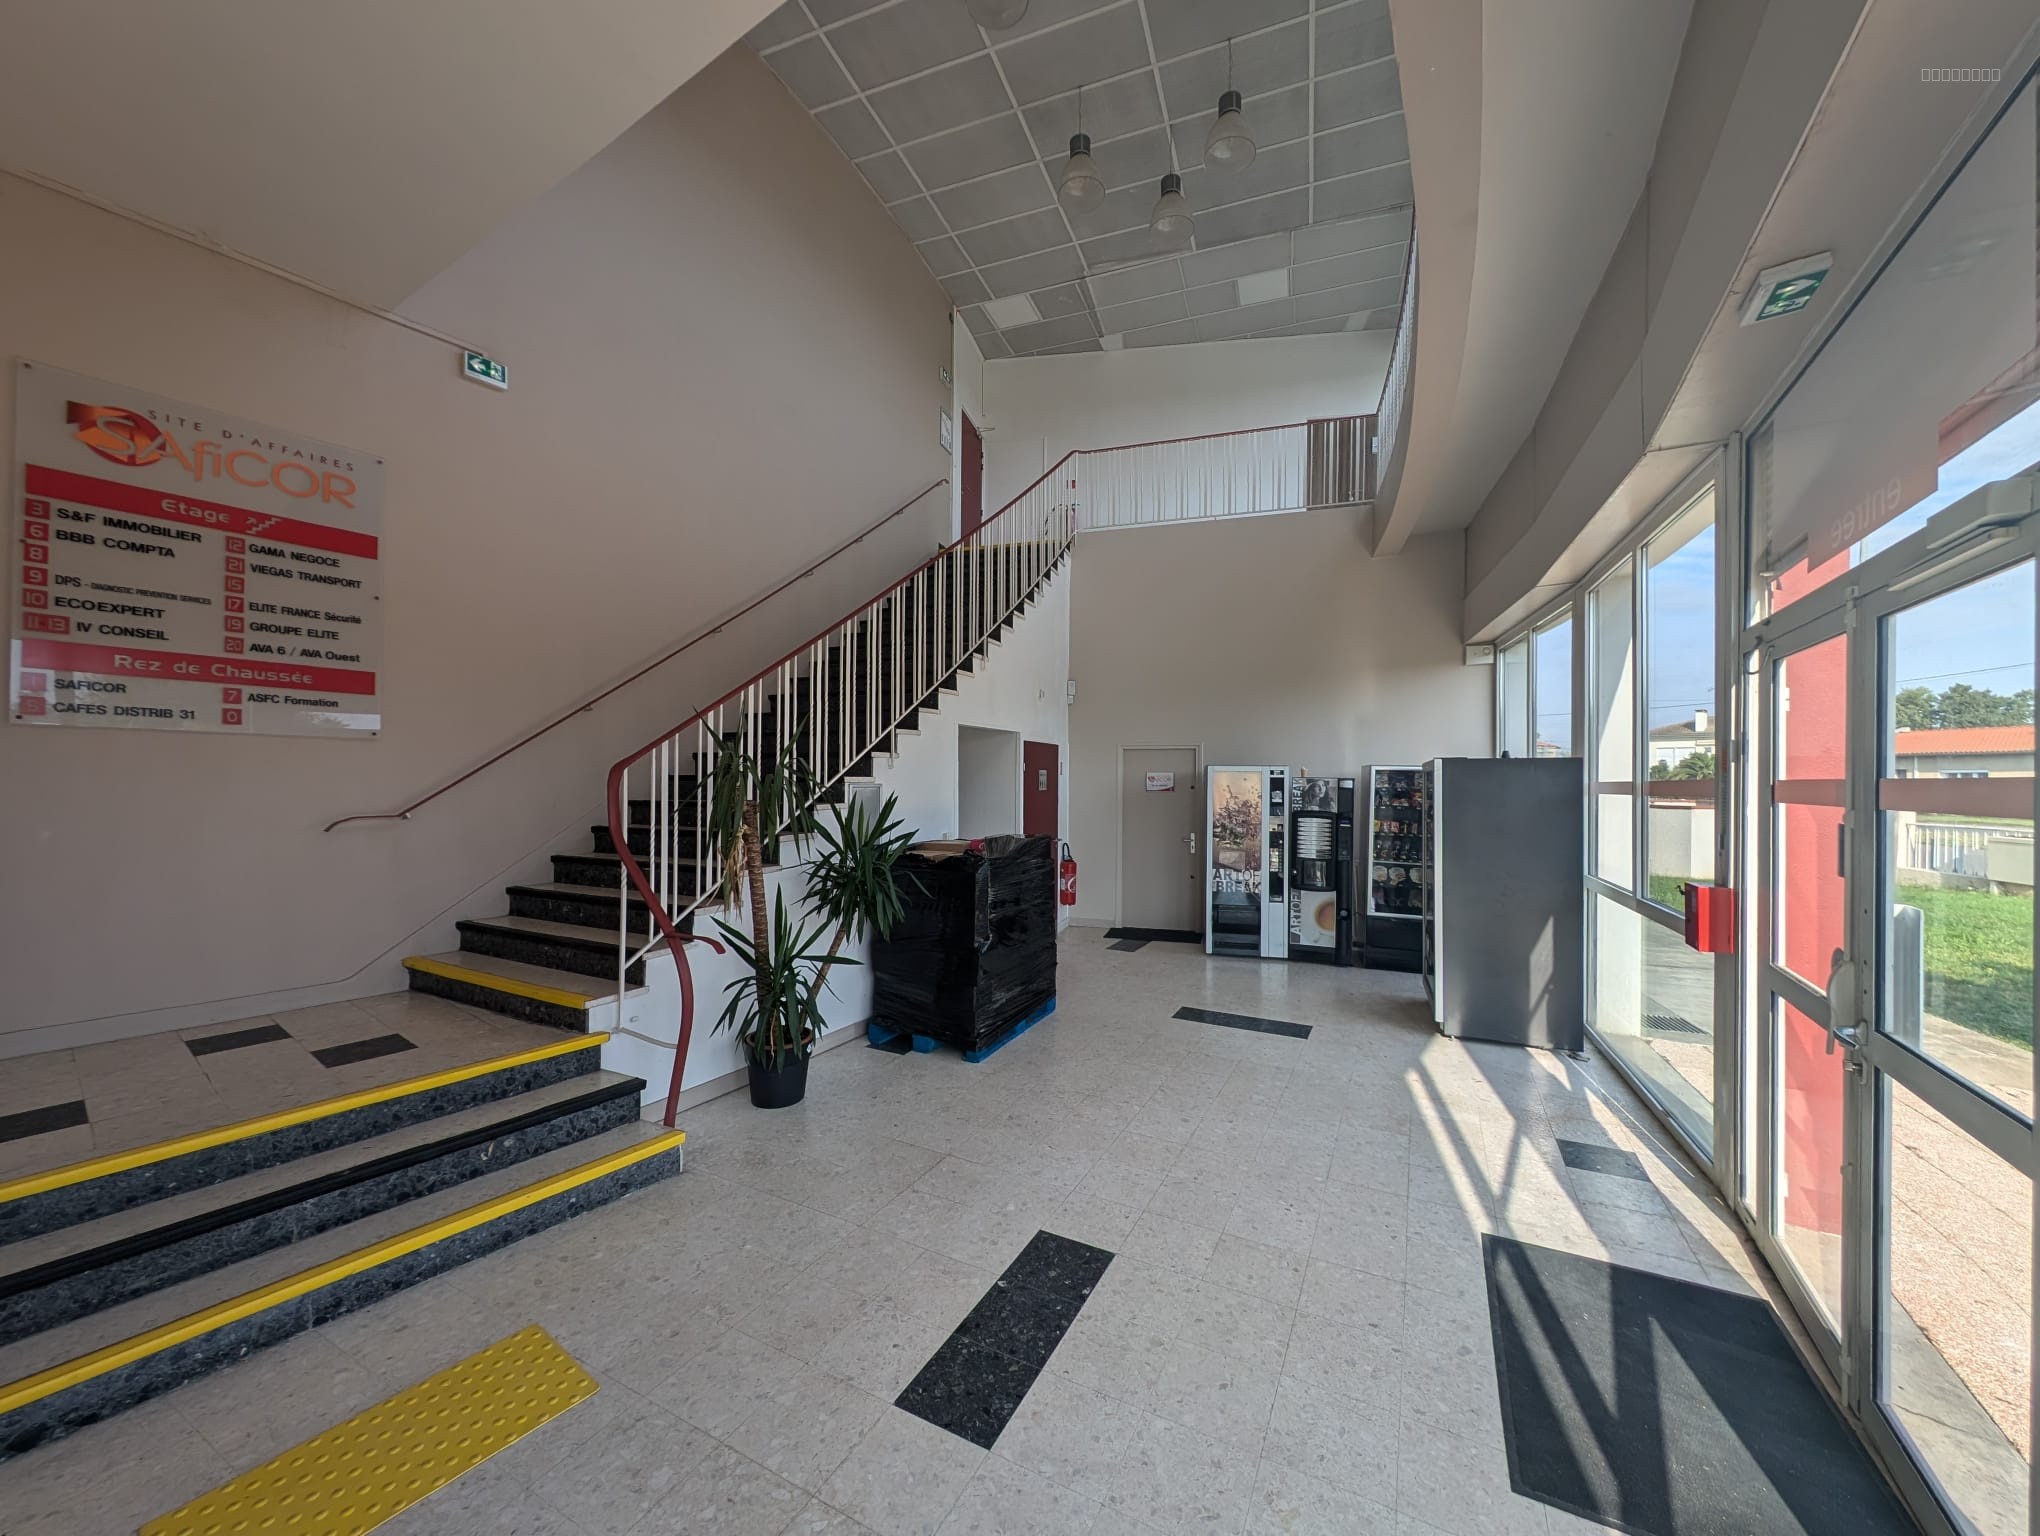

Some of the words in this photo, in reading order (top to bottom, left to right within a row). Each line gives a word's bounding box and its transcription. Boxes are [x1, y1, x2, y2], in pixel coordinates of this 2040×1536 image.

[147, 409, 204, 432] SITE
[221, 428, 355, 472] D'AFFAIRES
[32, 502, 44, 516] 3
[56, 507, 96, 524] S&F
[102, 516, 203, 544] IMMOBILIER
[160, 498, 231, 524] Etage
[29, 524, 43, 537] 6
[55, 529, 96, 545] BBB
[103, 537, 176, 559] COMPTA
[29, 546, 43, 560] 8
[228, 539, 242, 552] 12
[248, 543, 286, 559] GAMA
[290, 551, 341, 568] NEGOCE
[29, 569, 42, 583] 9
[54, 574, 82, 588] DPS
[90, 582, 134, 595] DIAGNOSTIC
[135, 588, 178, 601] PREVENTION
[228, 559, 243, 572] 21
[250, 563, 294, 579] VIEGAS
[297, 571, 362, 589] TRANSPORT
[228, 578, 242, 590] 15
[26, 591, 45, 605] 10
[228, 598, 242, 610] 17
[249, 602, 278, 614] ELITE
[281, 606, 321, 620] FRANCE
[324, 611, 362, 625] Sécurité
[76, 621, 92, 633] IV
[98, 623, 170, 641] CONSEIL
[227, 618, 242, 630] 19
[249, 621, 303, 636] GROUPE
[307, 628, 340, 641] ELITE
[249, 643, 274, 655] AVA
[277, 646, 286, 656] 6
[300, 648, 323, 659] AVA
[325, 651, 361, 663] Ouest
[113, 653, 162, 672] Rez
[172, 660, 201, 675] de
[210, 663, 313, 685] Chaussée
[54, 677, 127, 694] SAFICOR
[53, 702, 107, 716] CAFES
[113, 705, 174, 720] DISTRIB
[180, 709, 196, 720] 31
[227, 690, 239, 701] 7
[247, 693, 280, 705] ASFC
[284, 695, 339, 708] Formation
